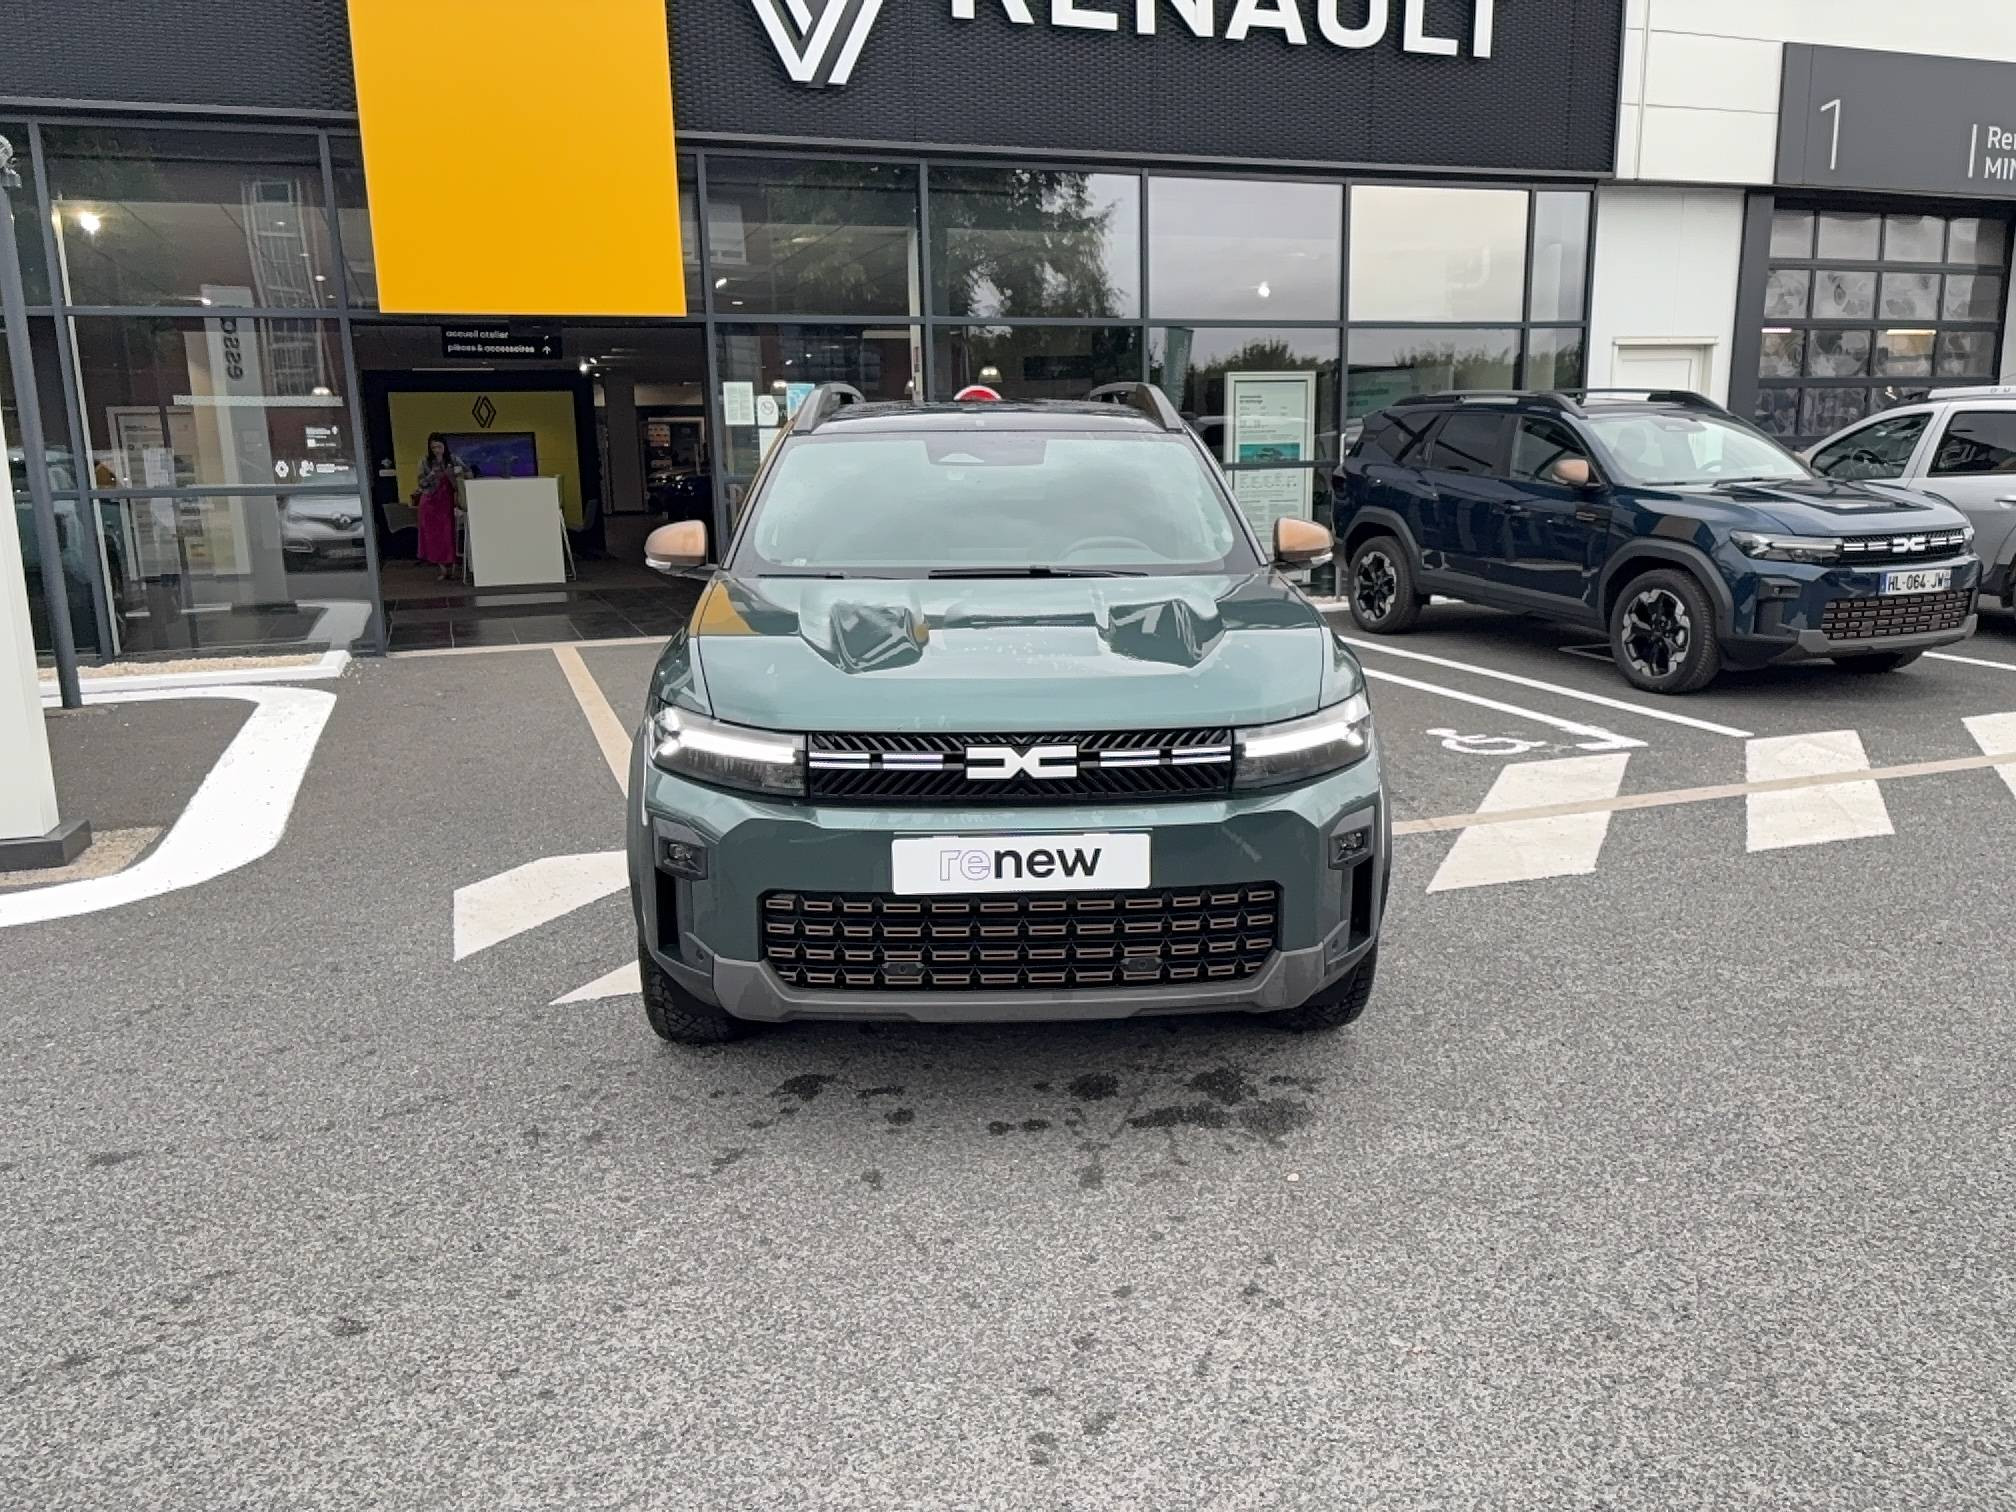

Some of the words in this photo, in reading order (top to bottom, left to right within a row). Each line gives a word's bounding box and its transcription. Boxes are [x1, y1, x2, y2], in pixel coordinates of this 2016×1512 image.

[951, 0, 1492, 58] NAULT
[1820, 99, 1841, 170] 1
[1987, 126, 2016, 150] Re
[940, 848, 1102, 881] renew
